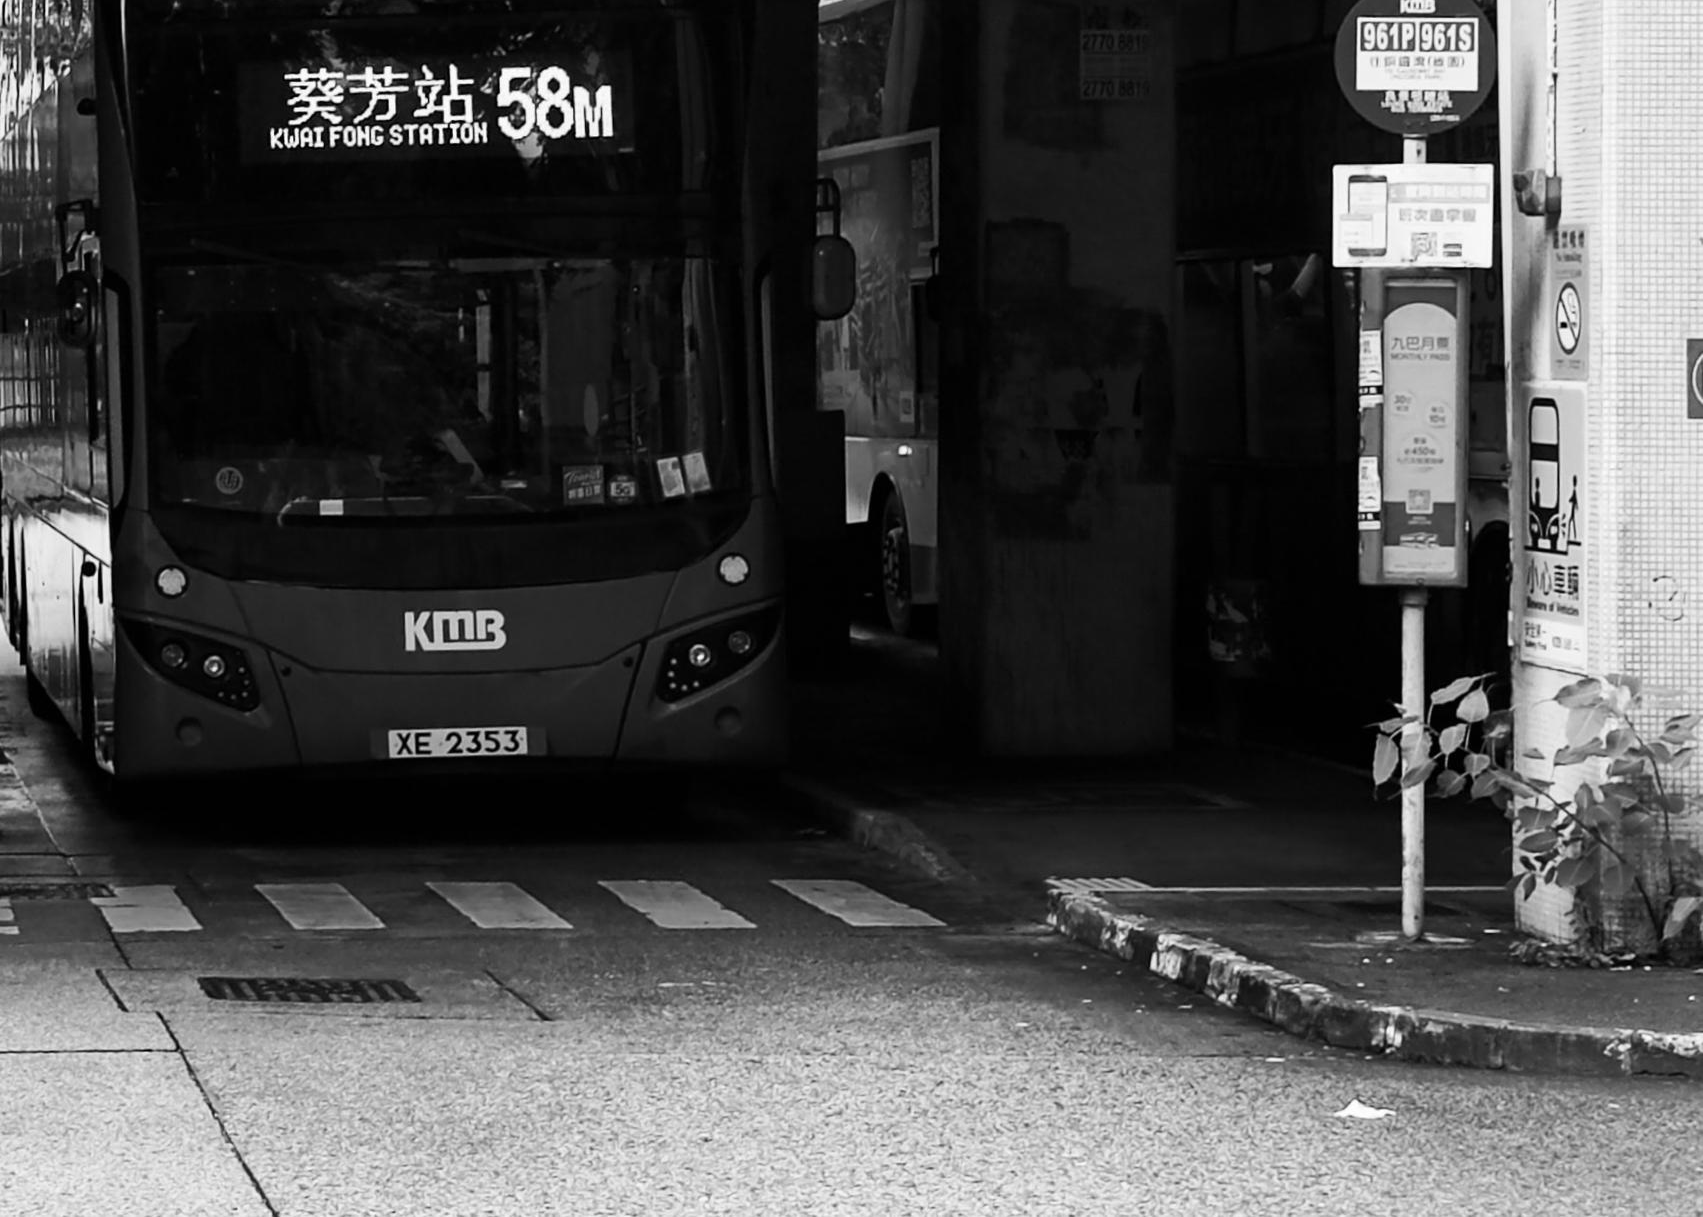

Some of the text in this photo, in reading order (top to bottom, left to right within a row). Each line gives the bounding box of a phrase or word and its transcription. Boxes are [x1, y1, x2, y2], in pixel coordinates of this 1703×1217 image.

[1082, 33, 1114, 51] 2770
[1362, 22, 1473, 52] 961P 961S
[284, 64, 475, 125] 葵芳站
[497, 66, 614, 140] 58M
[270, 122, 488, 149] KWAI FONG STATION
[1391, 336, 1450, 351] 九巴月票
[405, 610, 507, 651] KMB
[397, 730, 520, 755] XE 2353
